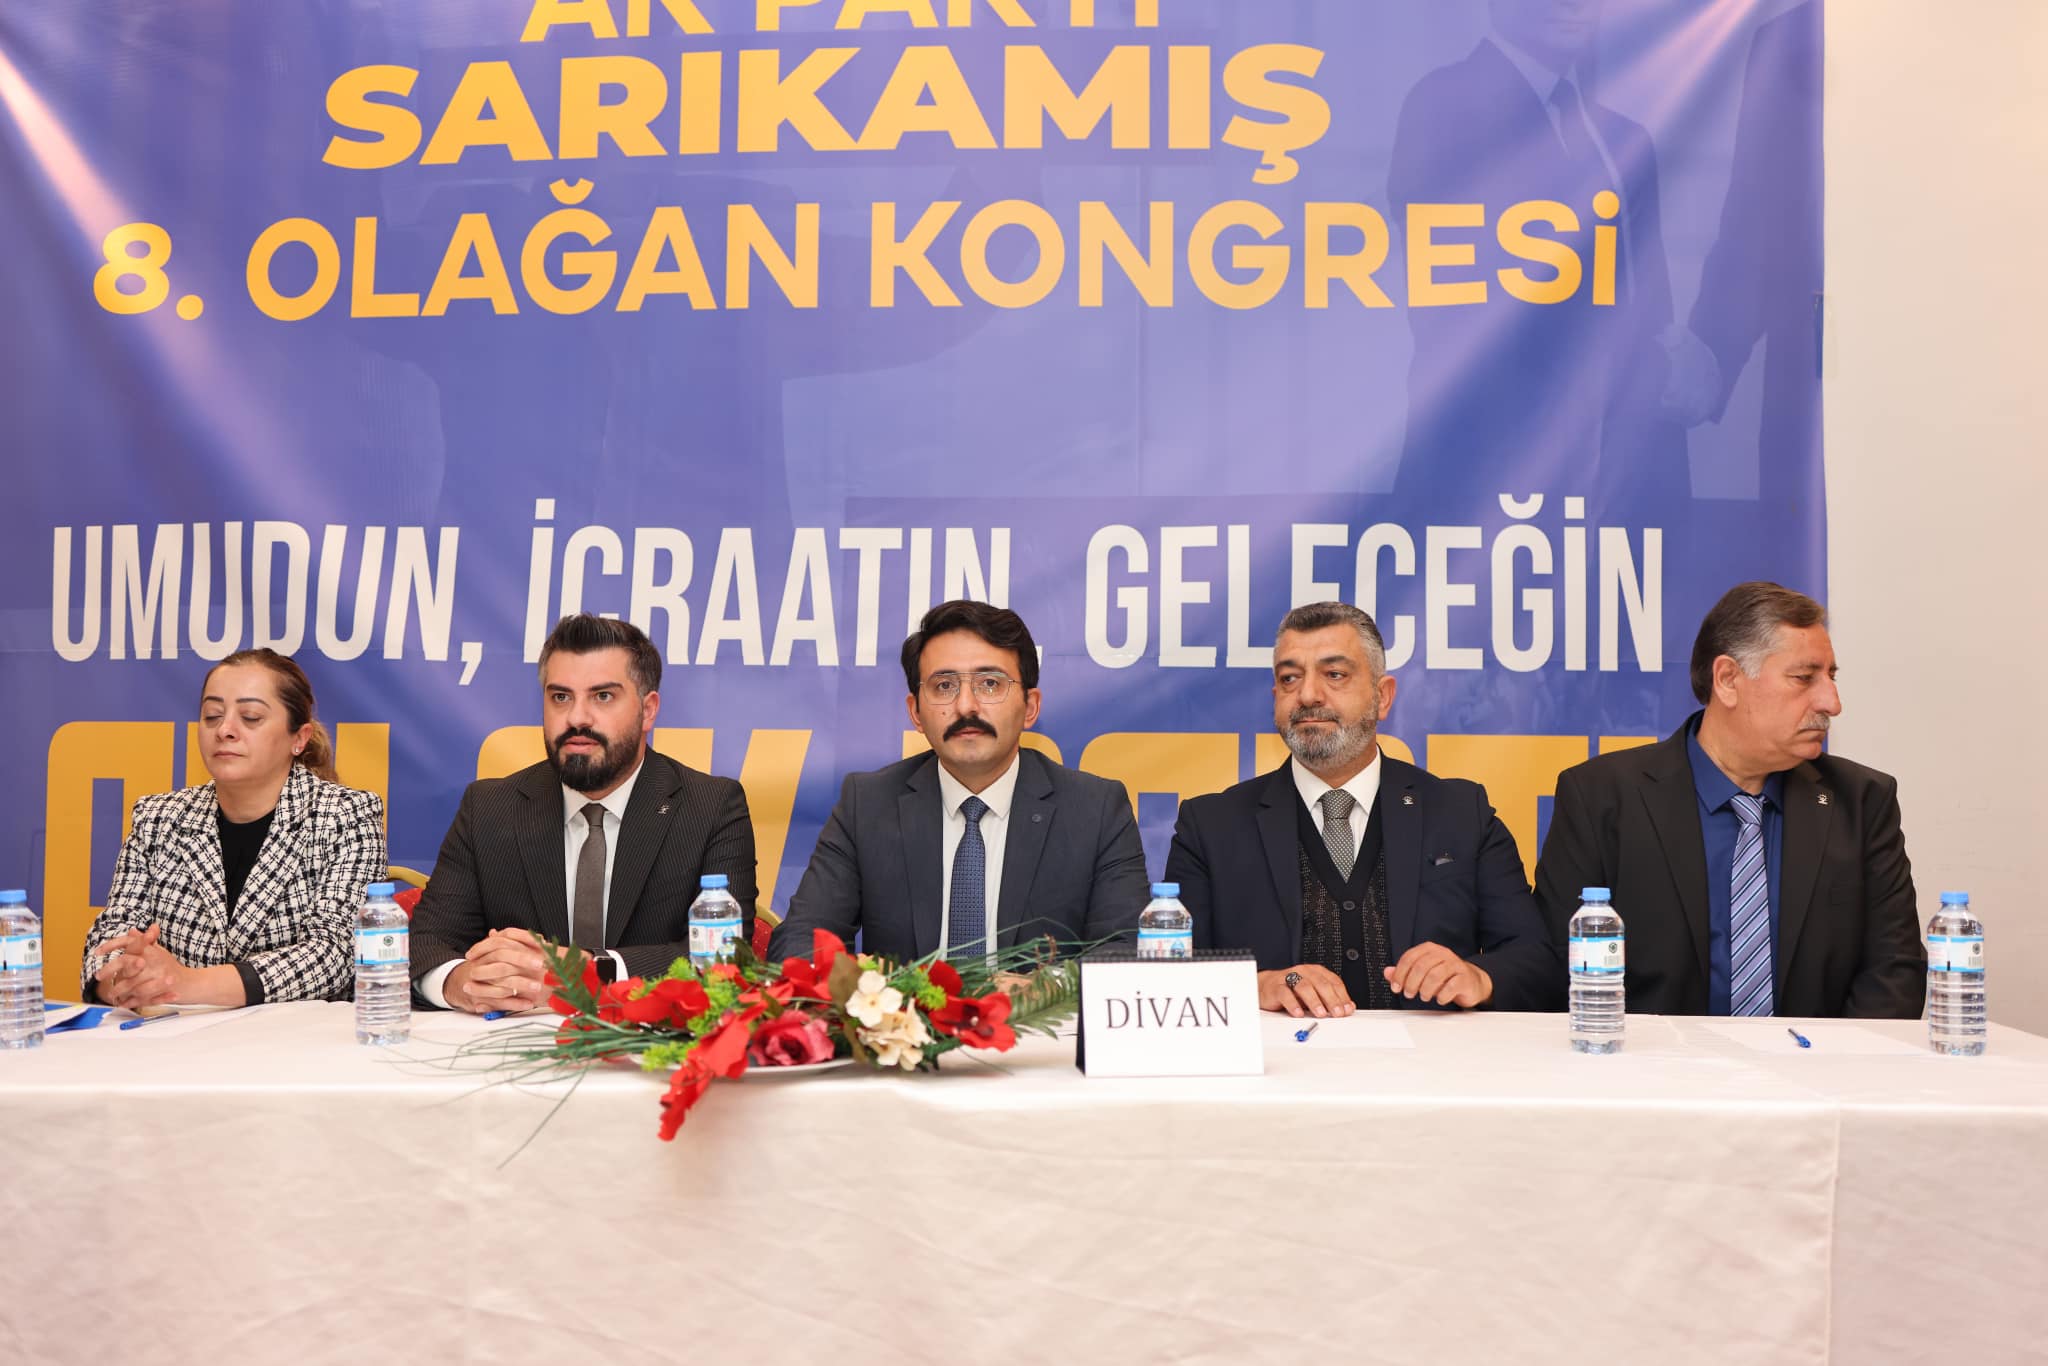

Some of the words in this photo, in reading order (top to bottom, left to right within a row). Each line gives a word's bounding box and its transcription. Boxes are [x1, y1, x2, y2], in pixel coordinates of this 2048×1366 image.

[323, 44, 1331, 184] SARIKAMIŞ
[93, 223, 204, 321] 8.
[246, 178, 820, 321] OLAĞAN
[870, 190, 1620, 309] KONGRESİ
[52, 521, 483, 686] UMUDUN,
[523, 498, 1043, 668] İCRAATIN
[1085, 494, 1662, 672] GELECEĞİN
[1105, 990, 1229, 1028] DİVAN
